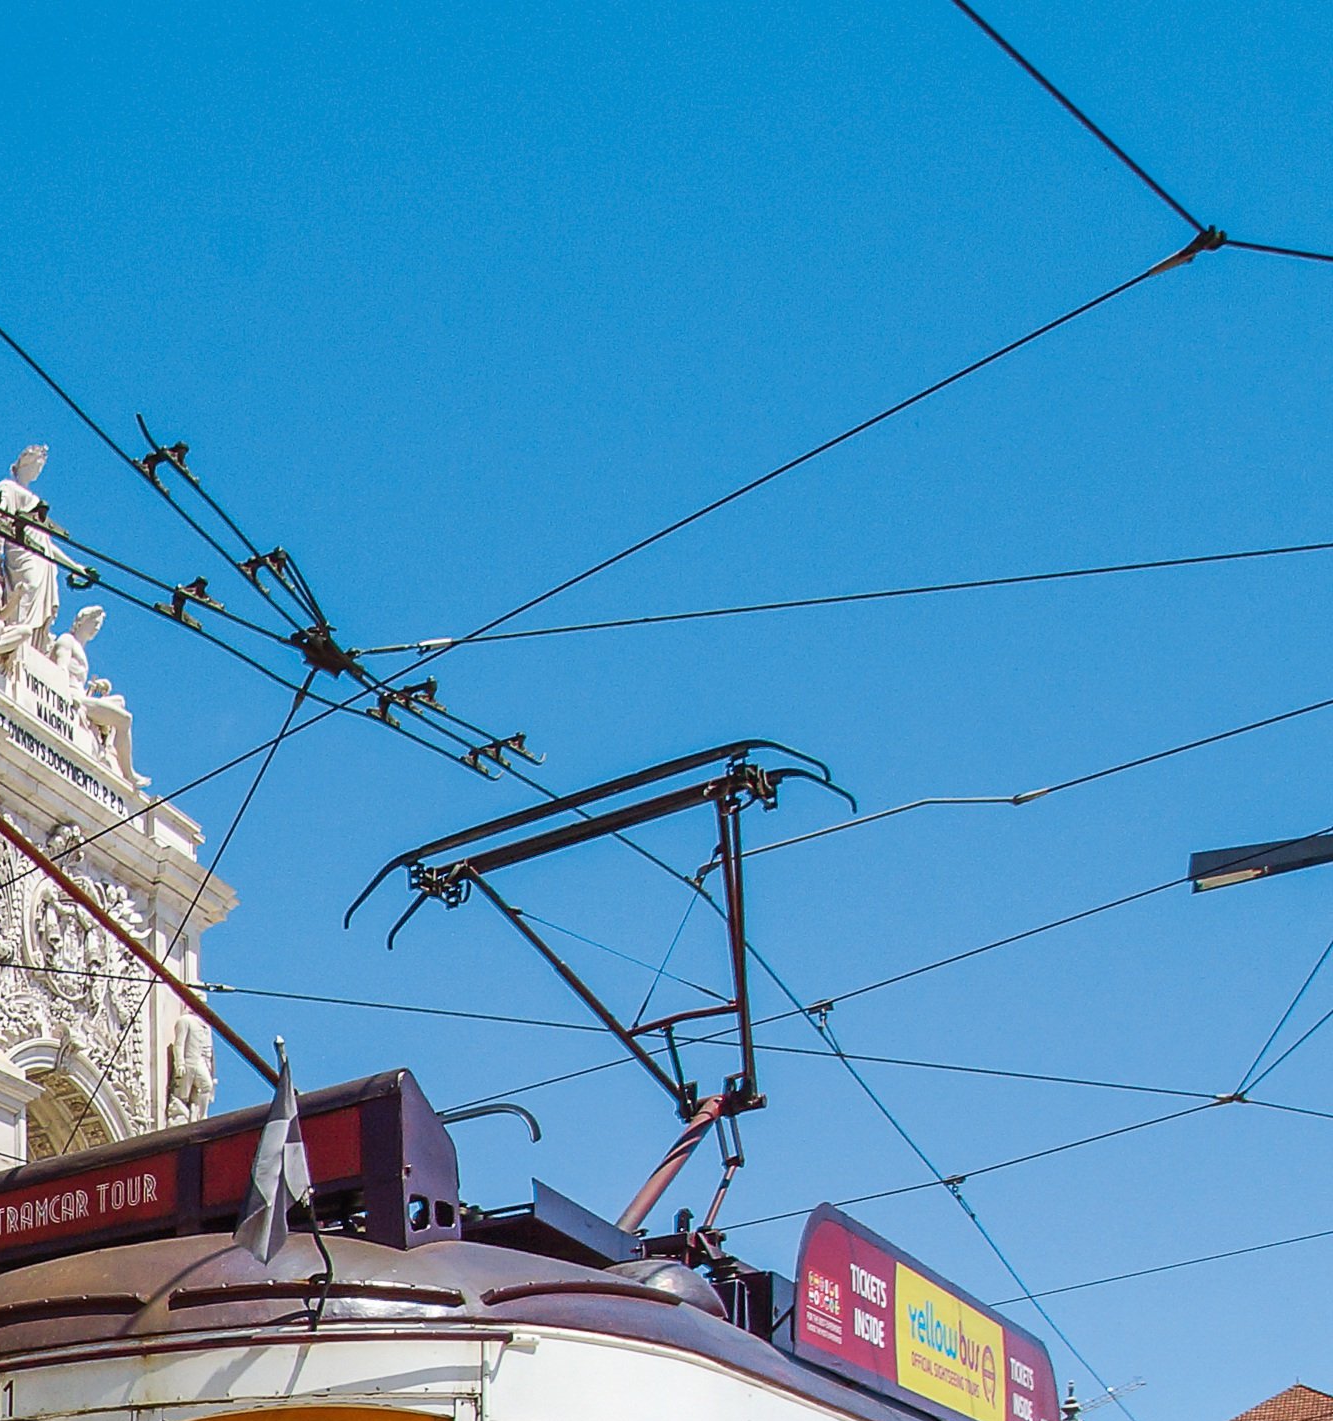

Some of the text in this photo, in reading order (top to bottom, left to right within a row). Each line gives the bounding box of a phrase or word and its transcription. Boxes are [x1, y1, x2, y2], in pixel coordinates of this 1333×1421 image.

[96, 1173, 158, 1214] TOUR
[850, 1263, 887, 1309] TICKETS
[853, 1307, 886, 1349] INSIDE
[1010, 1357, 1034, 1392] TICKETS
